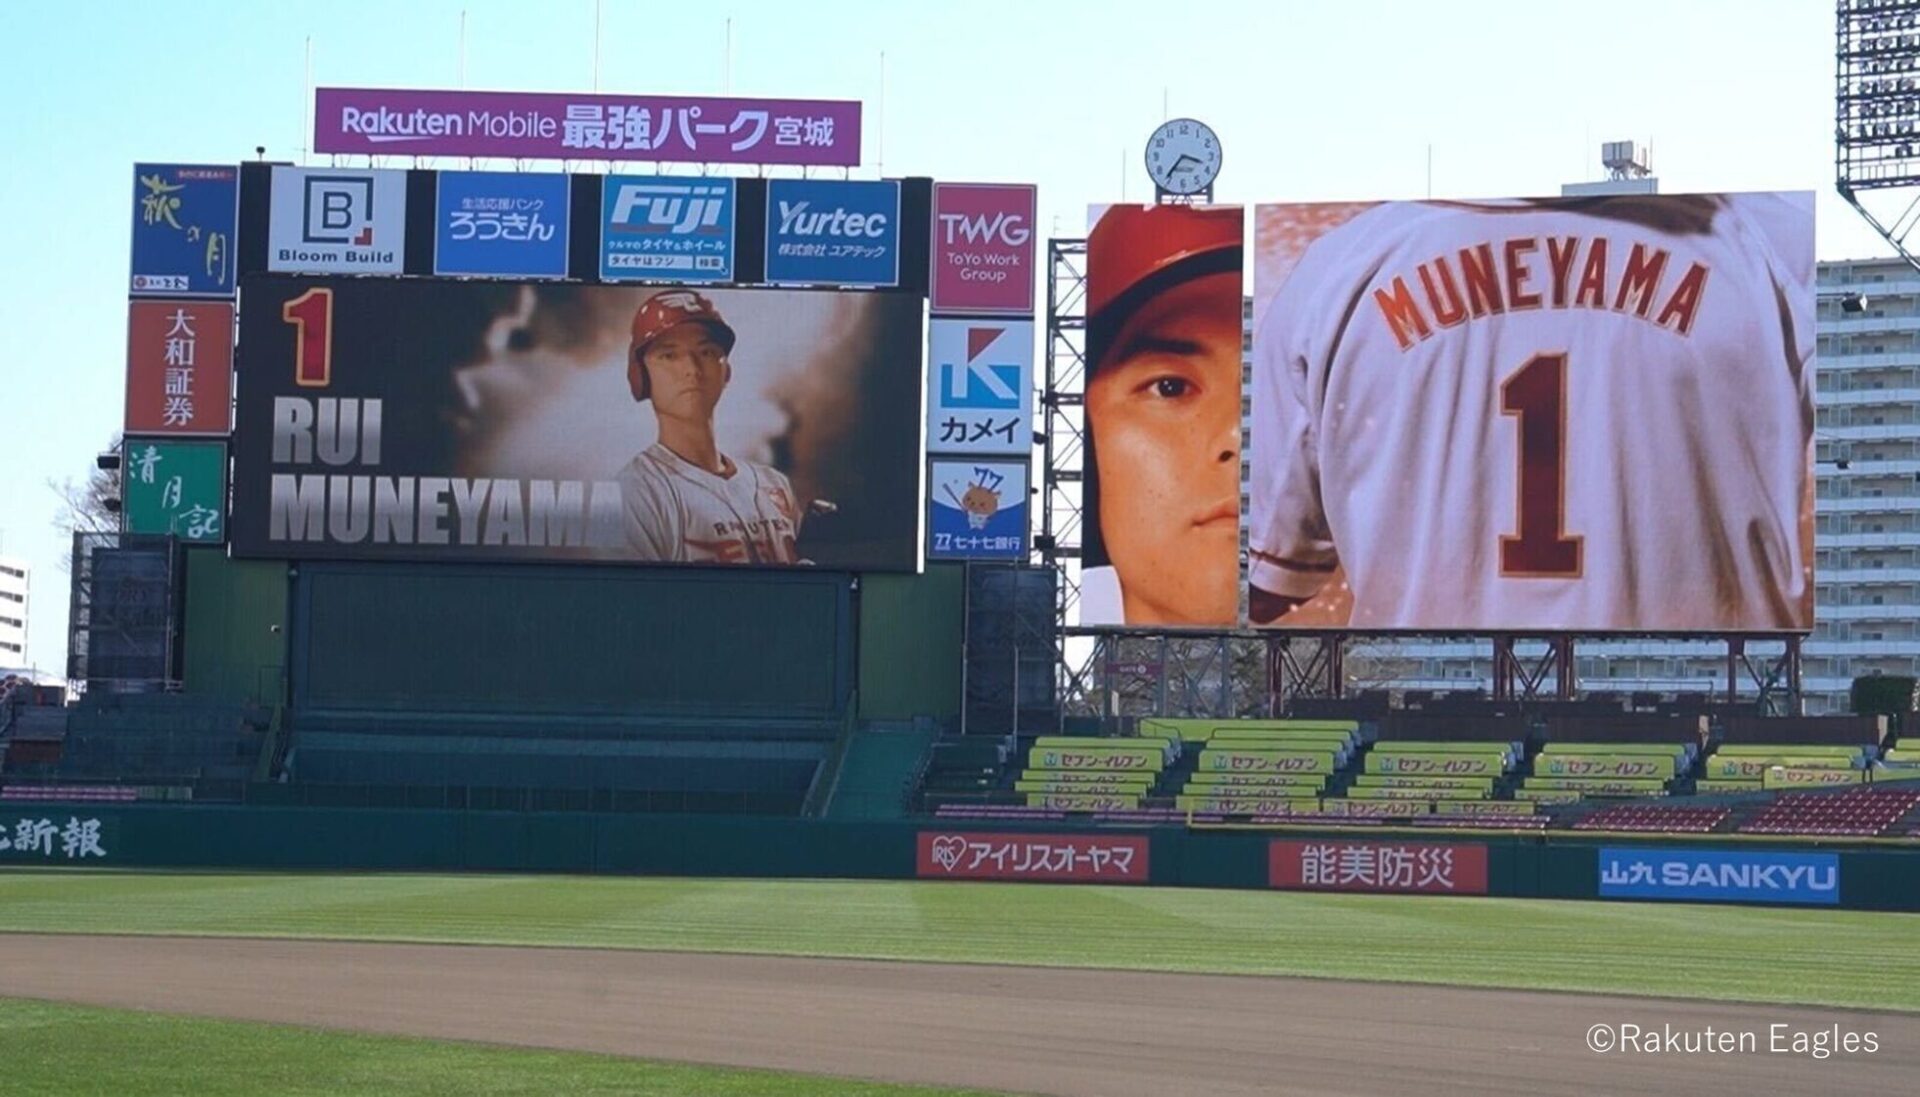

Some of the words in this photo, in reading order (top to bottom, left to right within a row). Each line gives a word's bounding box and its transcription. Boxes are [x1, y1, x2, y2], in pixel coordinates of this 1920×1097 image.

[342, 105, 462, 138] Rakuten
[468, 110, 557, 138] Mobile
[562, 104, 768, 151] 最強パーク
[774, 116, 834, 147] 宮城
[322, 190, 353, 229] B
[449, 211, 555, 241] ろうきん
[610, 184, 727, 234] Fuji
[778, 200, 887, 238] Yurtec
[939, 211, 1030, 247] TWG
[279, 249, 338, 262] Bloom
[345, 251, 393, 264] Build
[948, 252, 981, 265] ToYo
[984, 253, 1020, 266] Work
[960, 267, 1007, 283] Group
[1374, 235, 1711, 353] MUNEYAMA
[282, 287, 334, 387] 1
[163, 308, 196, 427] 大和証券
[271, 396, 382, 466] RUI
[939, 416, 1022, 445] カメイ
[1498, 351, 1584, 580] 1
[269, 473, 626, 548] MUNEYAMA
[954, 535, 1021, 551] 七十七銀行
[968, 842, 1135, 873] アイリスオーヤマ
[1301, 844, 1454, 889] 能美防災
[1602, 861, 1657, 886] 山九
[1662, 863, 1836, 891] SANKYU
